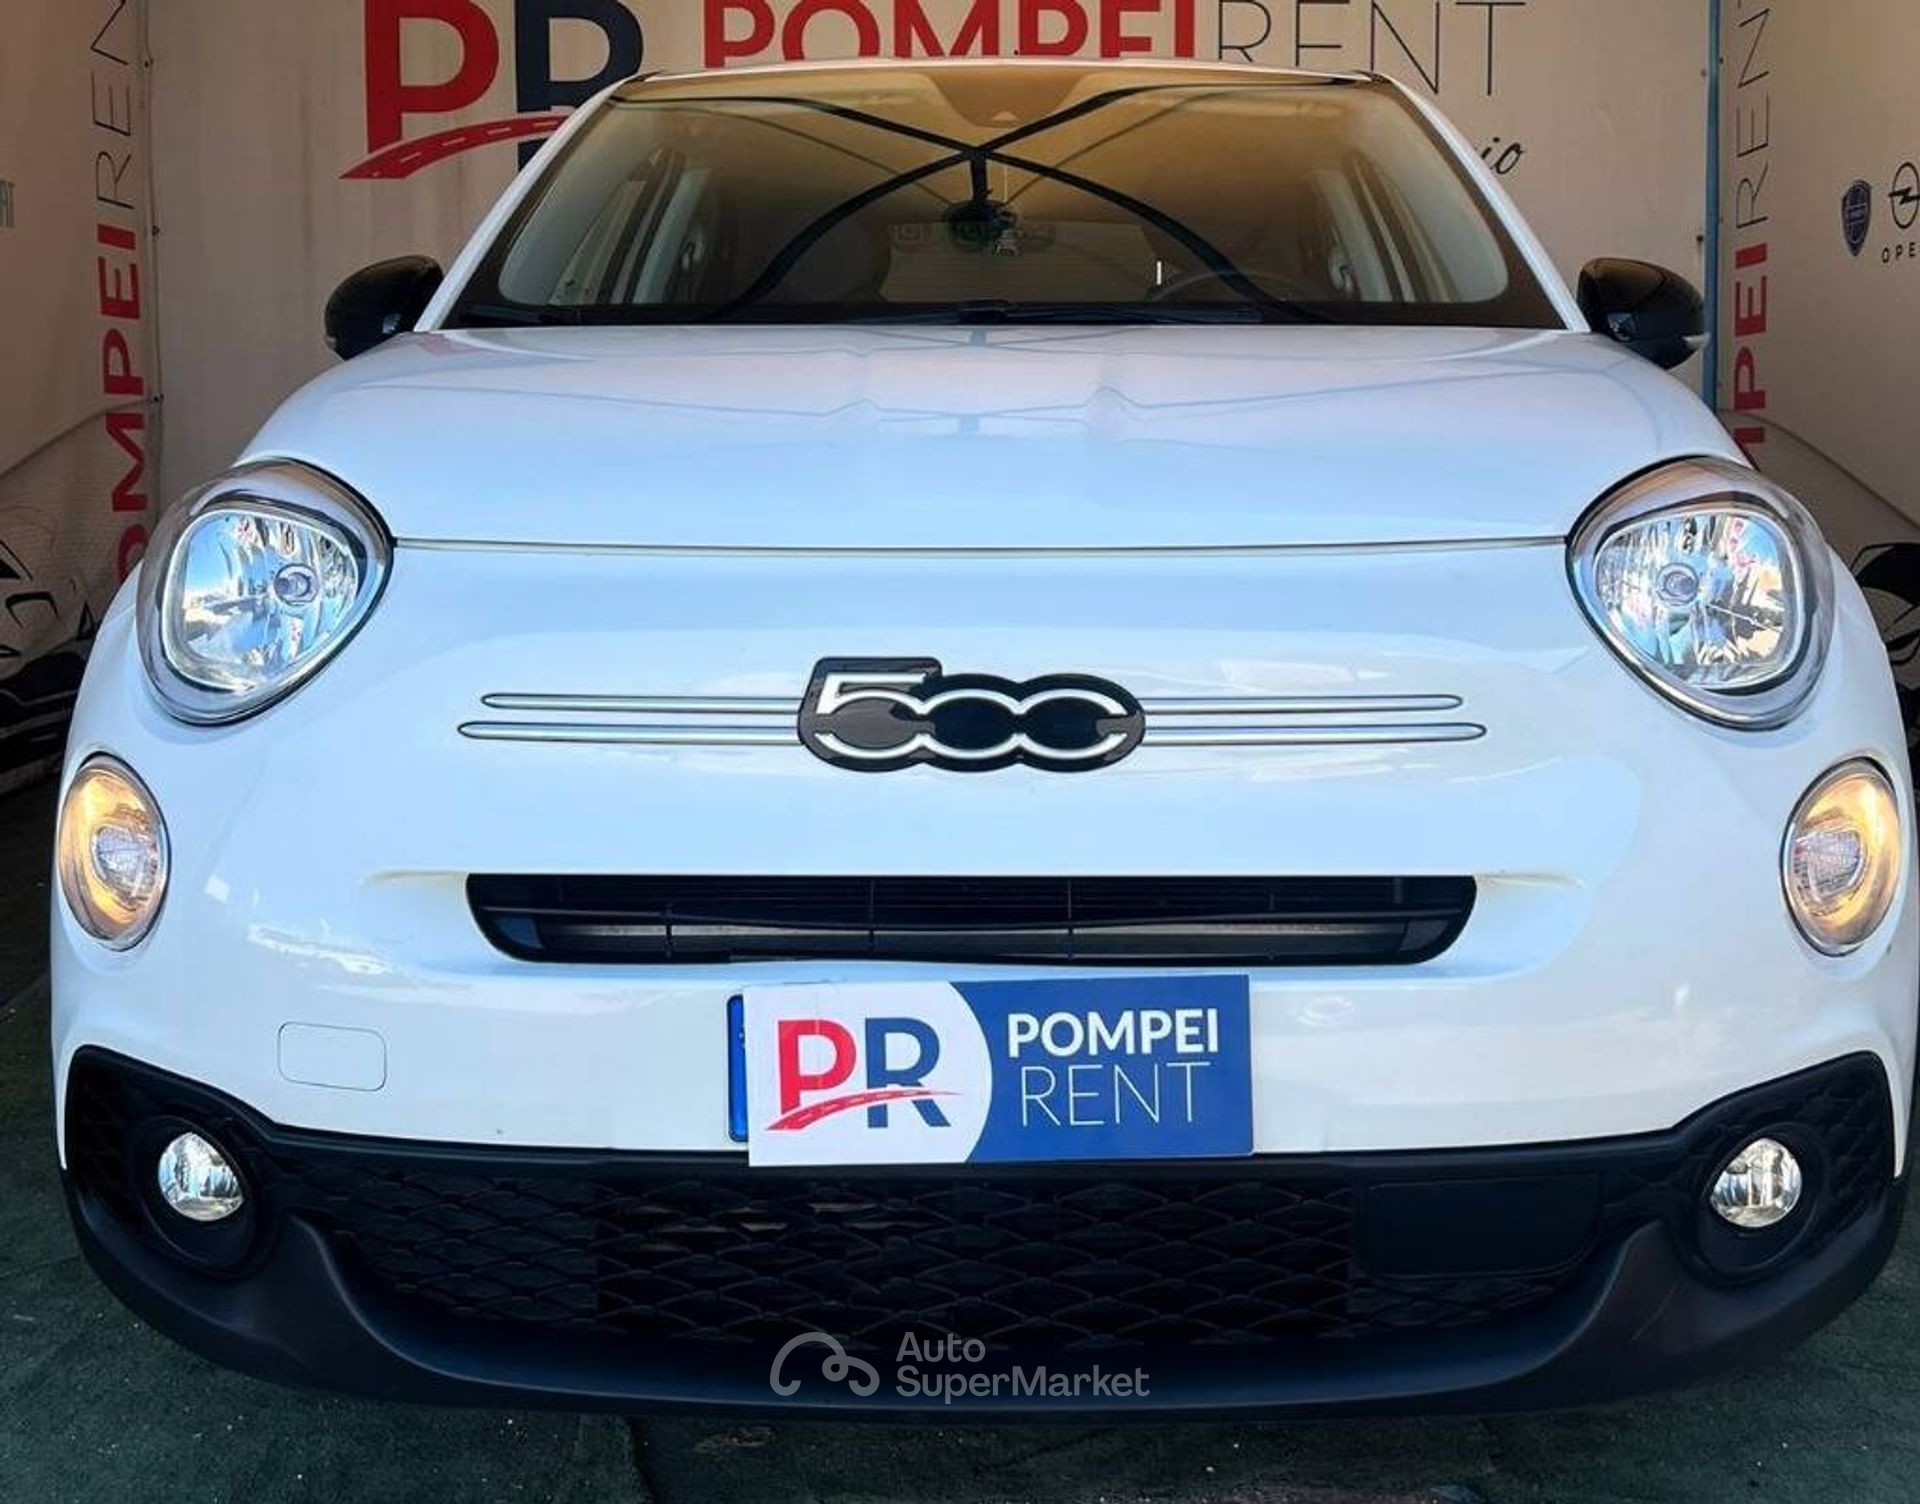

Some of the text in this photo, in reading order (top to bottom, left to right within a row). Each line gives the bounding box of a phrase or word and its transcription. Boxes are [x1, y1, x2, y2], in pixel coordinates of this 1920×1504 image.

[1735, 0, 1769, 229] REN
[812, 671, 1129, 760] 500
[776, 1017, 951, 1129] PR
[1007, 1008, 1219, 1058] POMPEI
[1021, 1061, 1211, 1127] RENT
